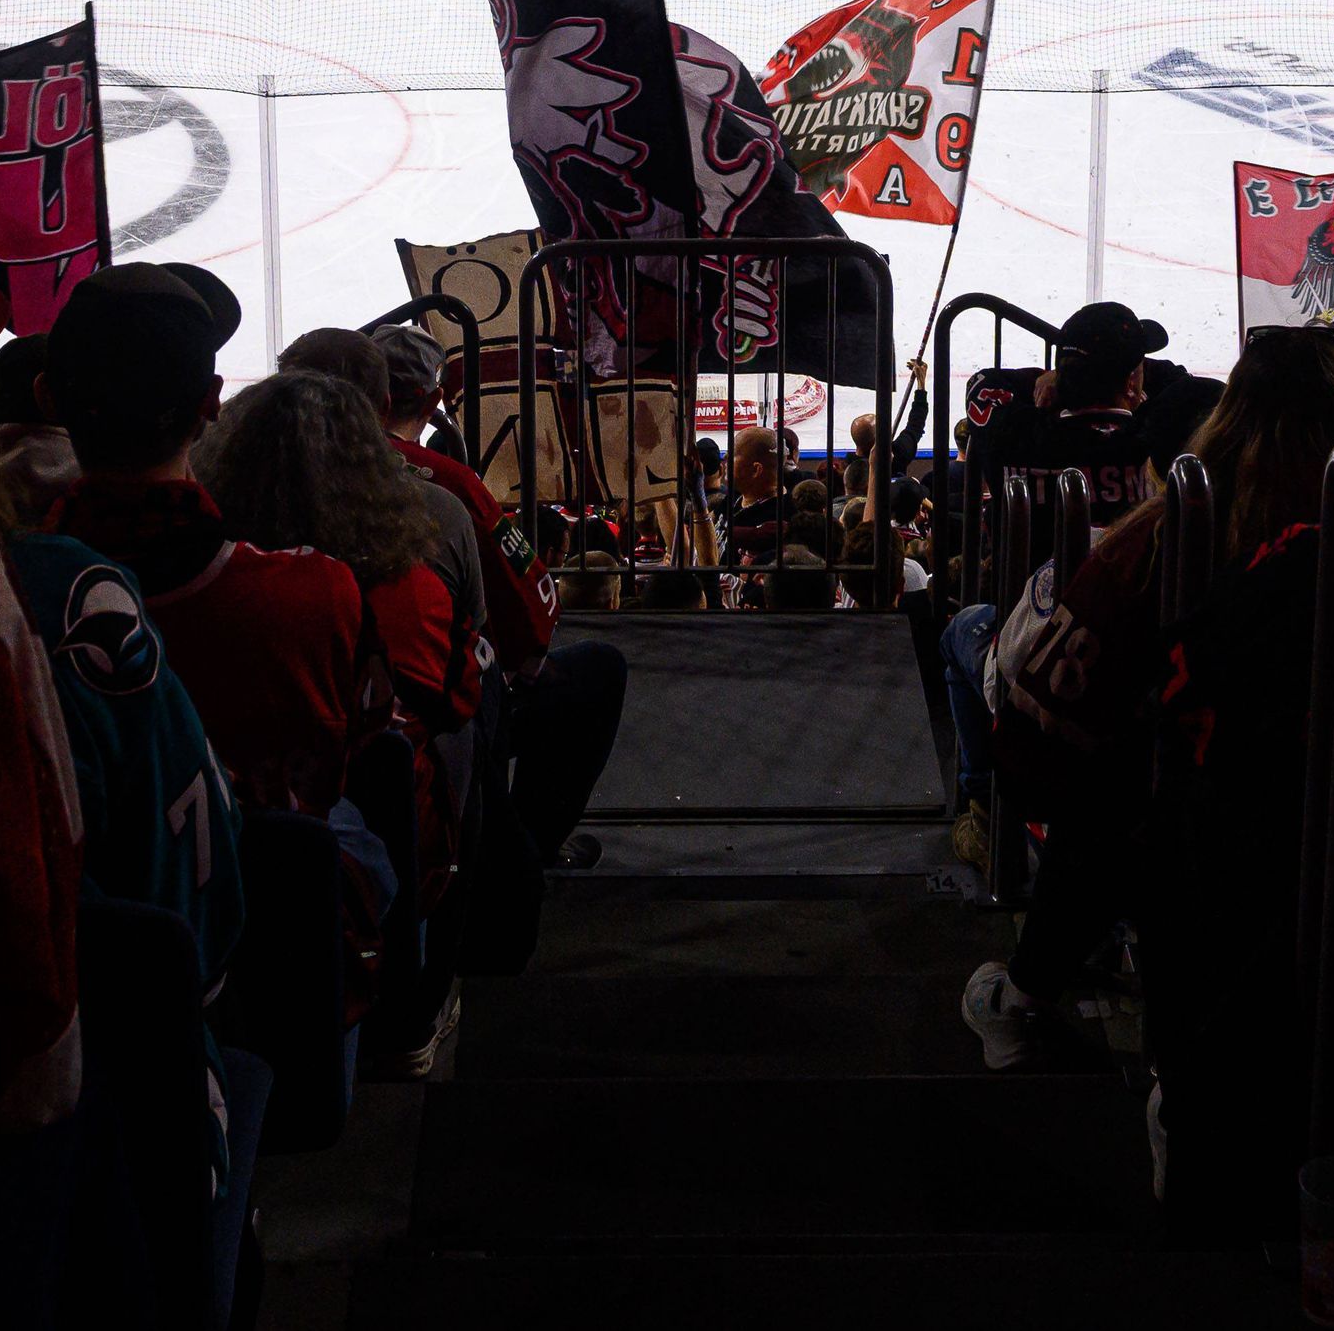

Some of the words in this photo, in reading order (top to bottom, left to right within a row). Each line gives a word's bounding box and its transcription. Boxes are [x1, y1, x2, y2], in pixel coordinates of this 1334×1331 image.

[734, 406, 758, 417] PEN
[537, 572, 557, 618] 9
[1026, 602, 1101, 703] 78
[931, 875, 955, 890] 14
